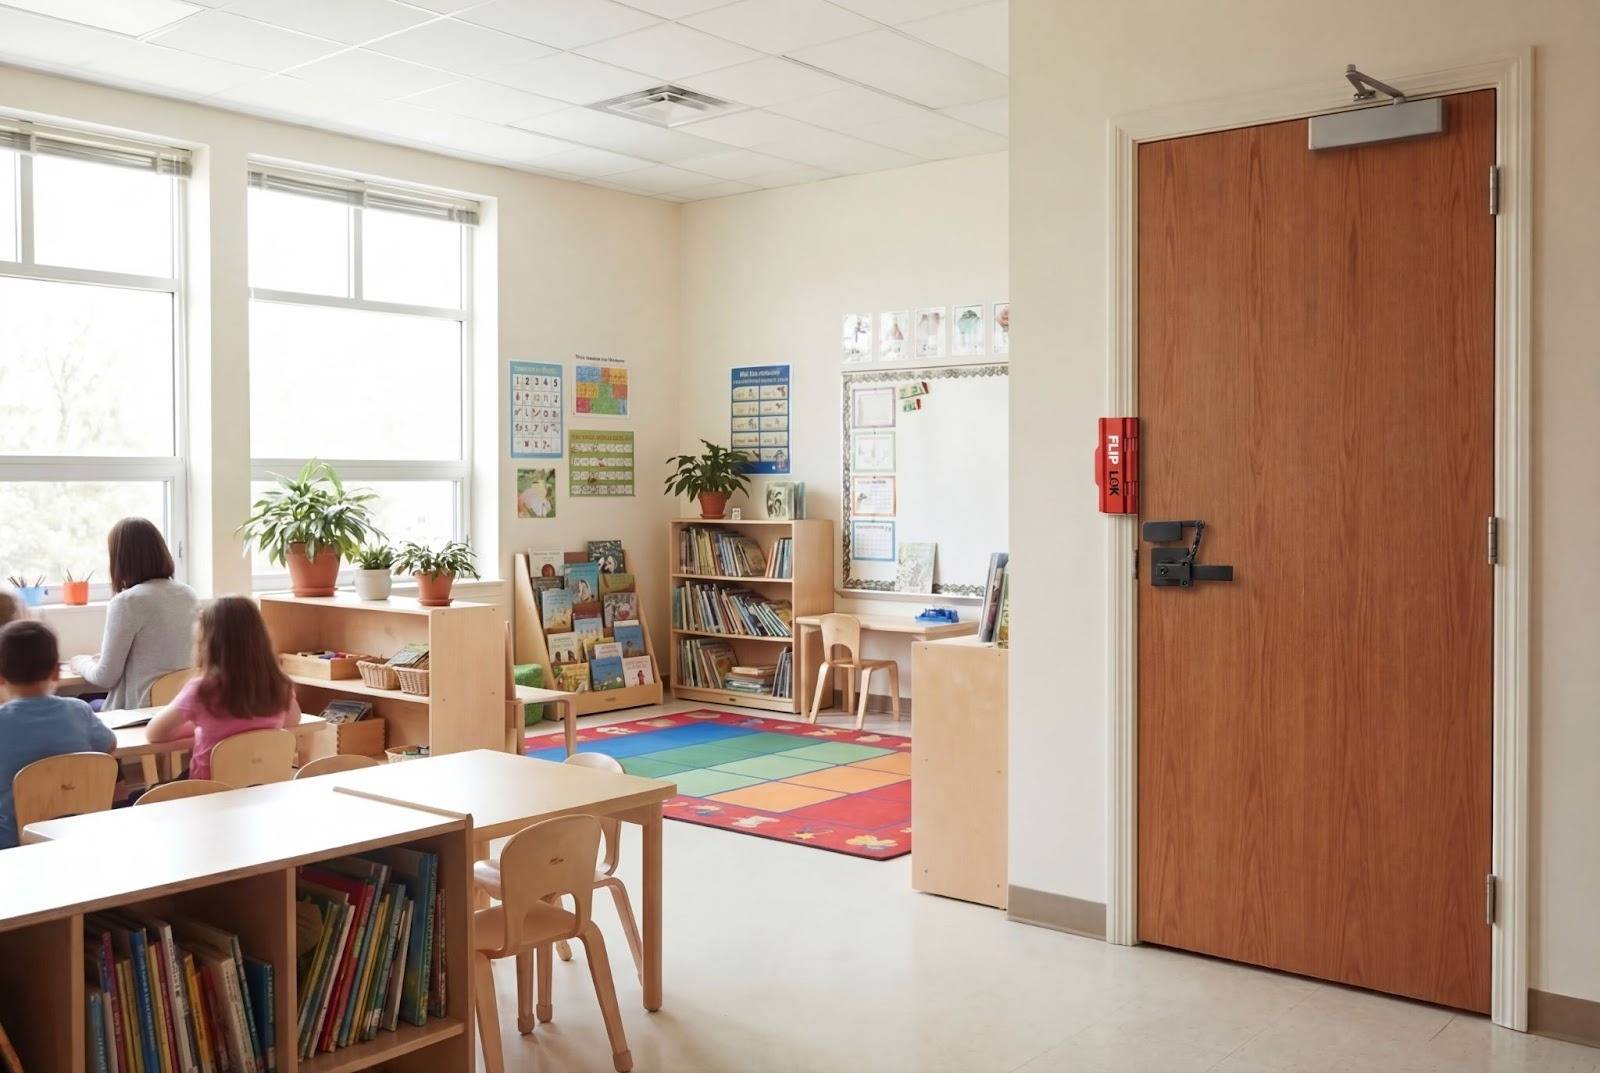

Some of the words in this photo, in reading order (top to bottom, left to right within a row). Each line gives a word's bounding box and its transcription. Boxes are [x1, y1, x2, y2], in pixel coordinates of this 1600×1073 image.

[525, 377, 530, 385] 2
[535, 378, 539, 386] 3
[554, 379, 558, 387] 5
[1108, 435, 1119, 464] FLIP
[1108, 470, 1120, 496] LOK
